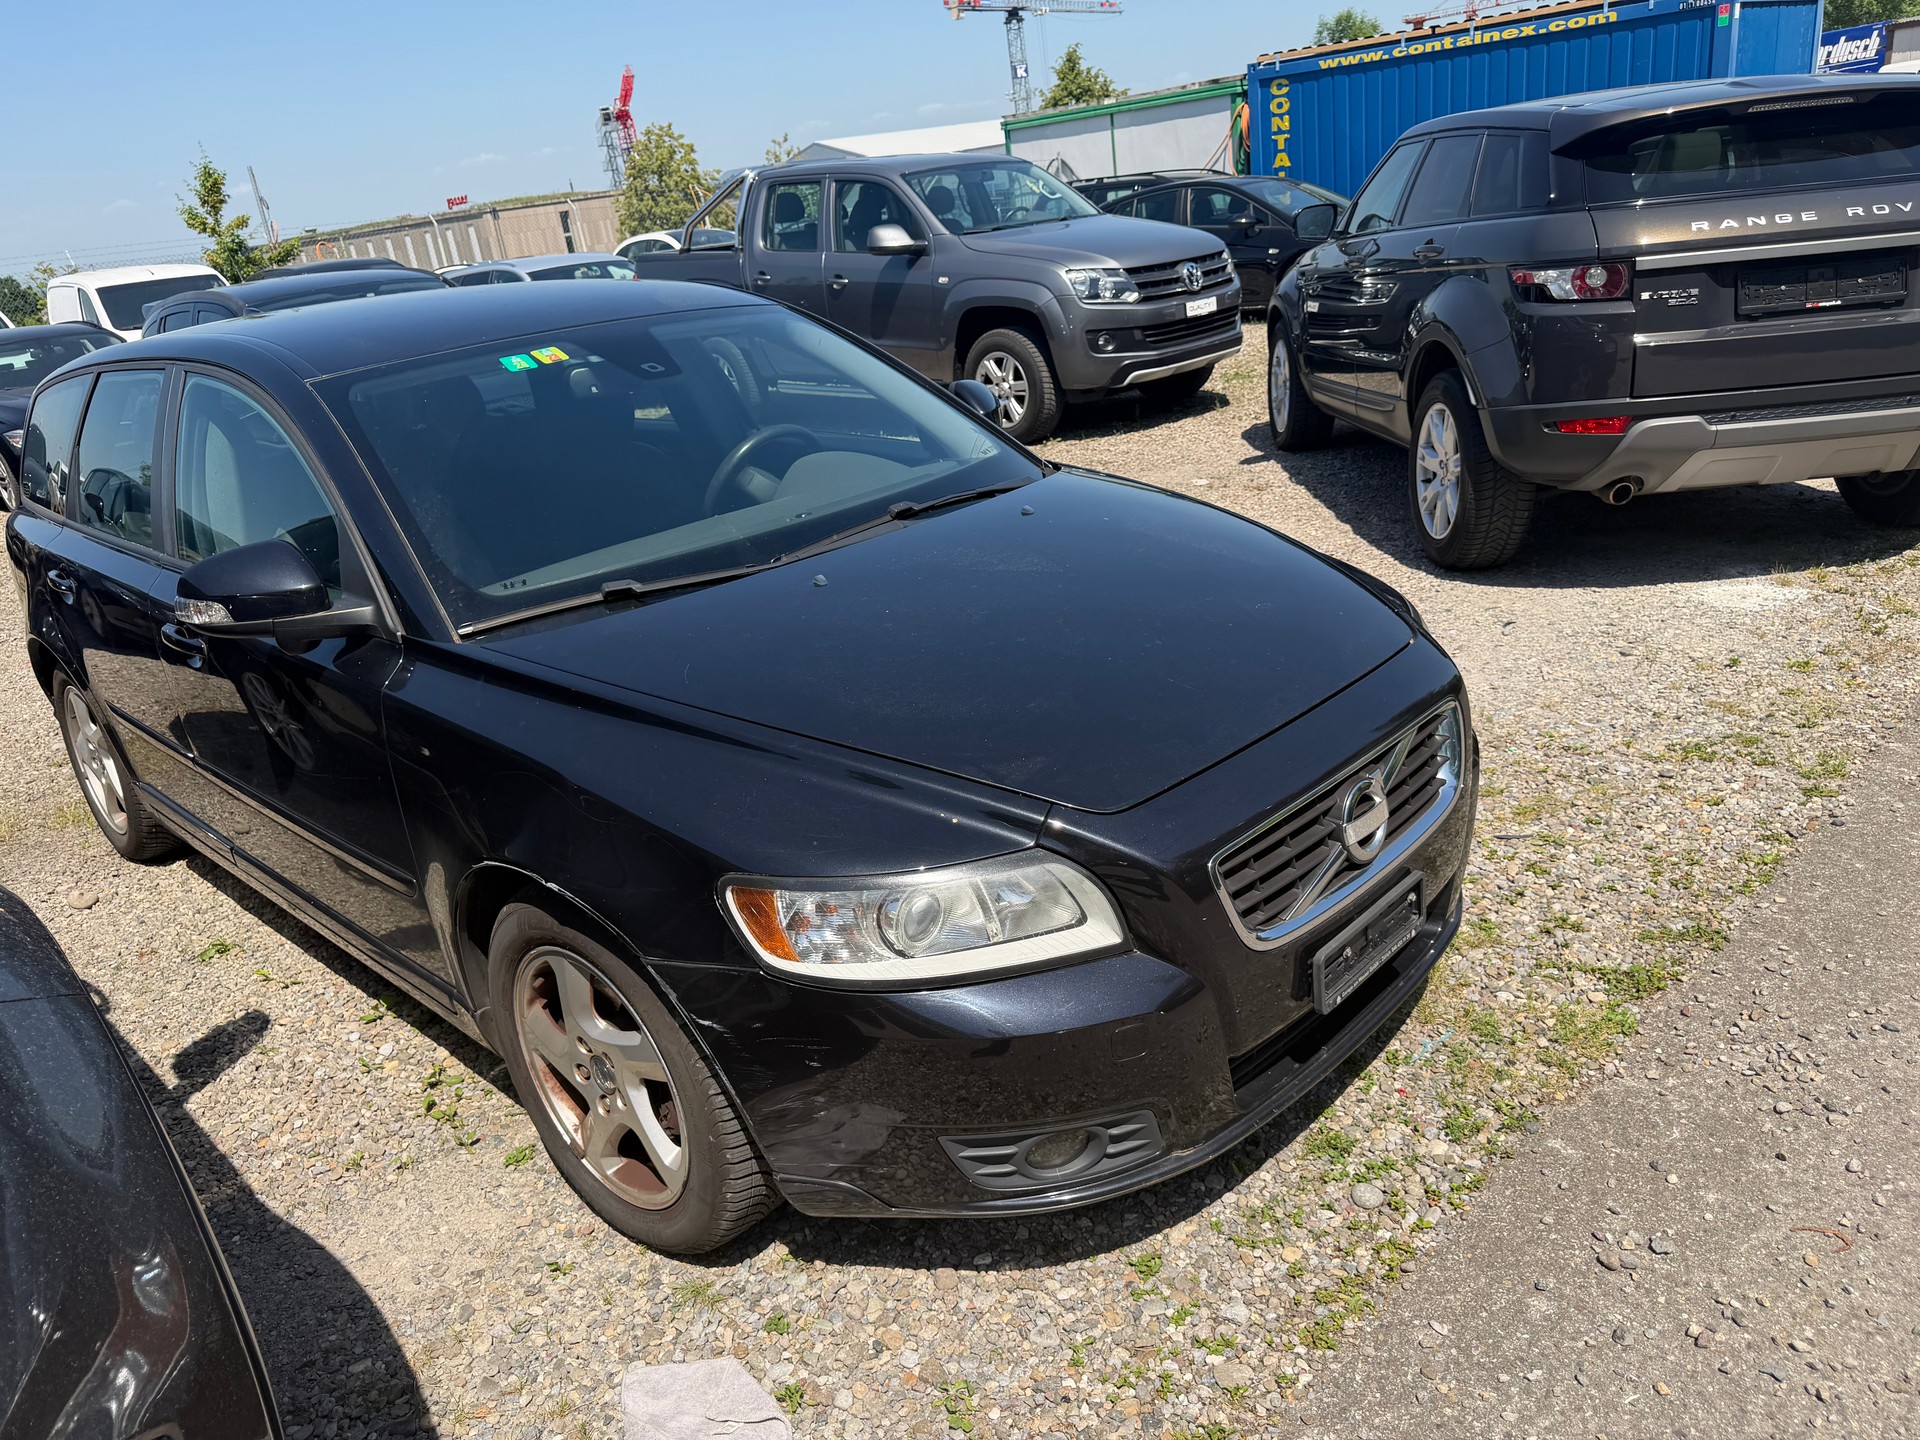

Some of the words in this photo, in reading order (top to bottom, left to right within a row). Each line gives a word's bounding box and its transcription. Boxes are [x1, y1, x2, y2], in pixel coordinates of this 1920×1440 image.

[1318, 11, 1618, 70] www.containex.com
[1691, 211, 1818, 231] RANGE
[1846, 202, 1913, 217] ROV
